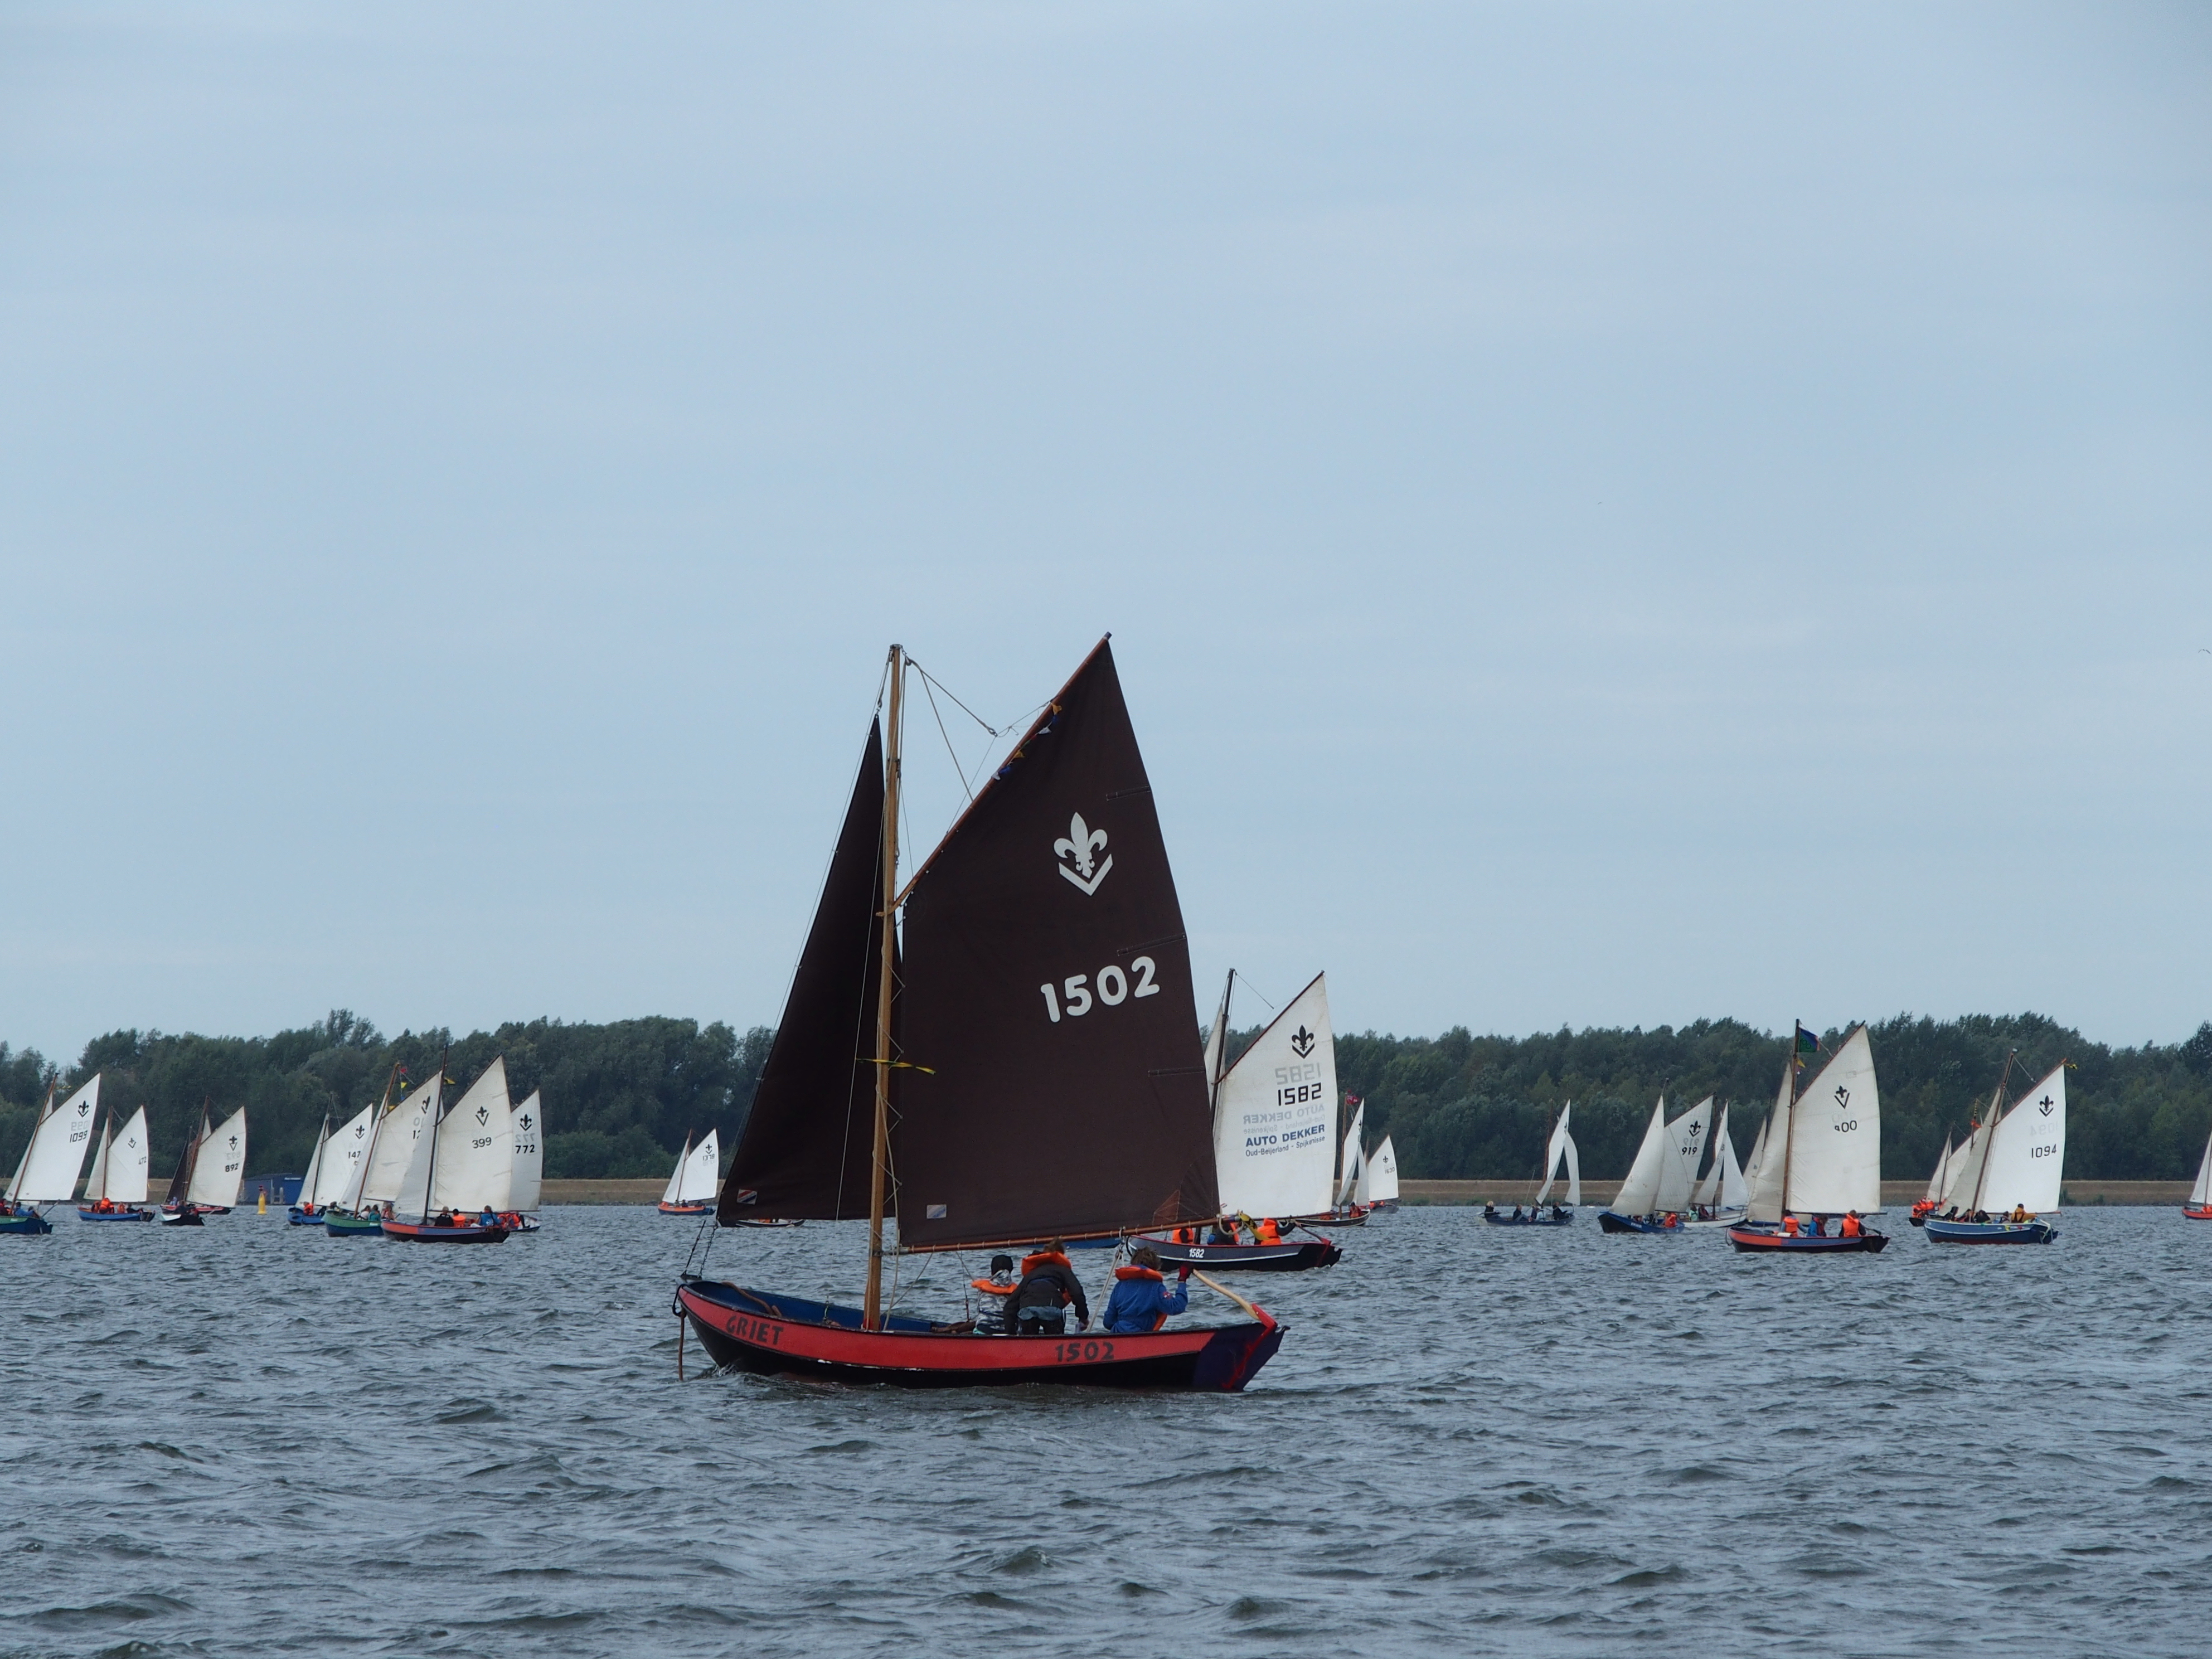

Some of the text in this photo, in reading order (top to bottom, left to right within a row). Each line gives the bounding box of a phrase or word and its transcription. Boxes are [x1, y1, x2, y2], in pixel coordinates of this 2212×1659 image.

[1040, 956, 1160, 1023] 1502
[1278, 1082, 1322, 1107] 1582
[70, 1130, 88, 1143] 1099
[1245, 1124, 1325, 1147] AUTO DEKKER
[472, 1137, 492, 1149] 399
[515, 1144, 535, 1154] 772
[1245, 1144, 1289, 1157] Oud-Beijerland
[1296, 1136, 1325, 1149] Spijkenisse
[348, 1151, 361, 1159] 147
[1682, 1147, 1697, 1156] 919
[2031, 1143, 2056, 1158] 1094
[225, 1163, 238, 1172] 892
[1189, 1248, 1205, 1258] 1582
[726, 1316, 784, 1345] GRIET
[1055, 1341, 1114, 1362] 1502
